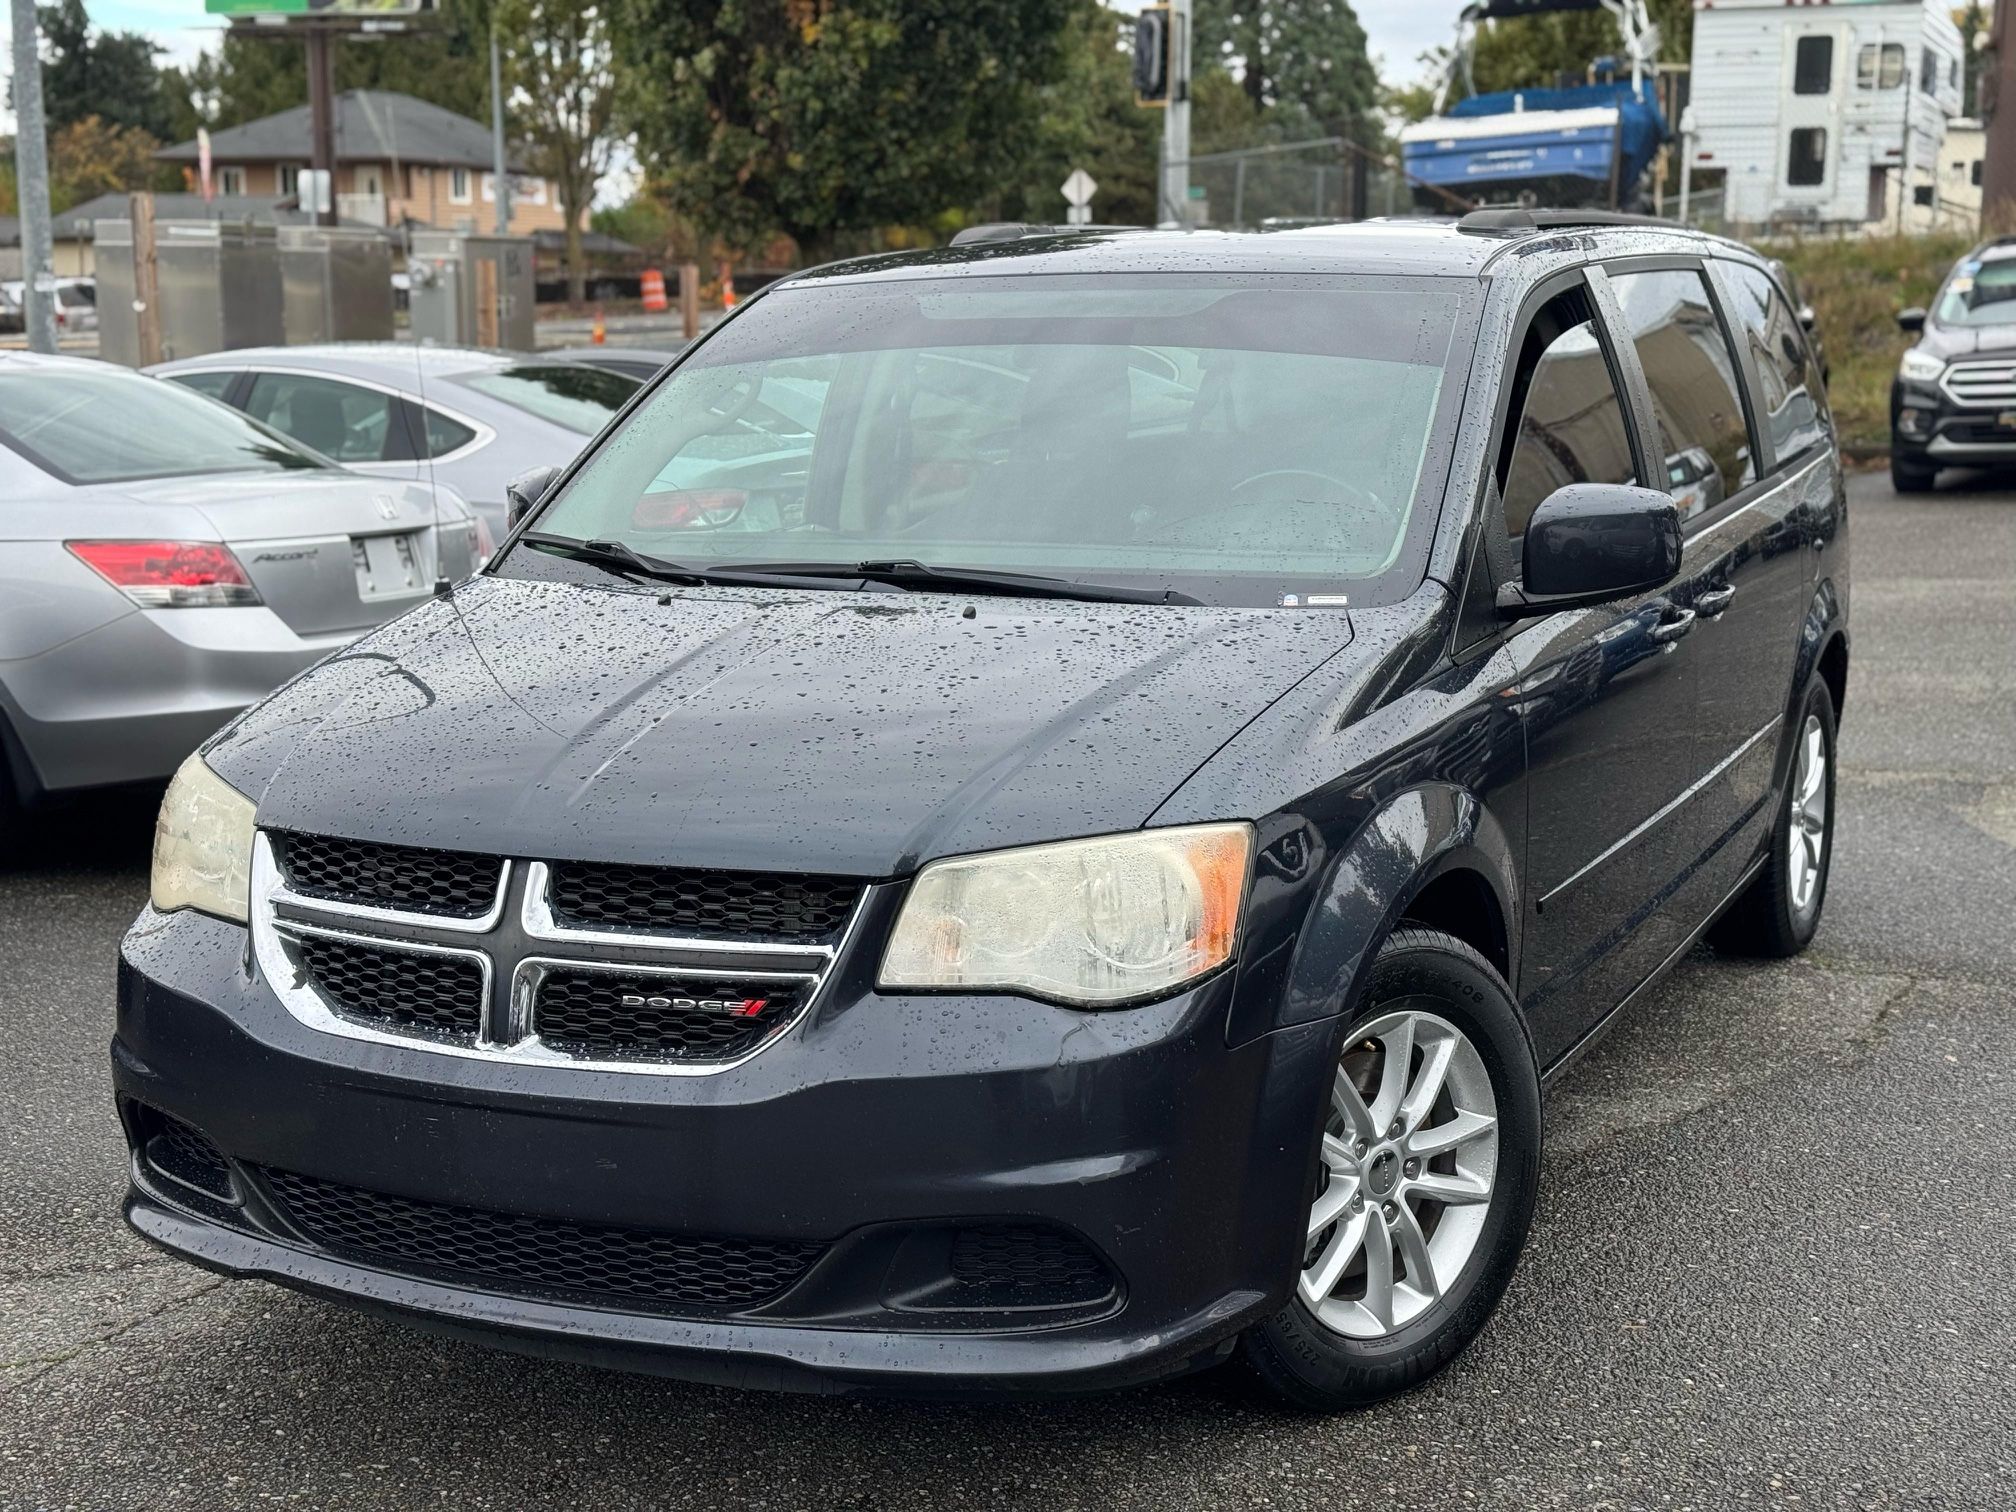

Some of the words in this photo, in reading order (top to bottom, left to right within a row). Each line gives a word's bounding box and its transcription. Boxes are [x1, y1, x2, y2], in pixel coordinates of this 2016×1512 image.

[254, 549, 318, 563] Accord
[622, 995, 746, 1011] DODGE
[1275, 1311, 1321, 1367] 225/65
